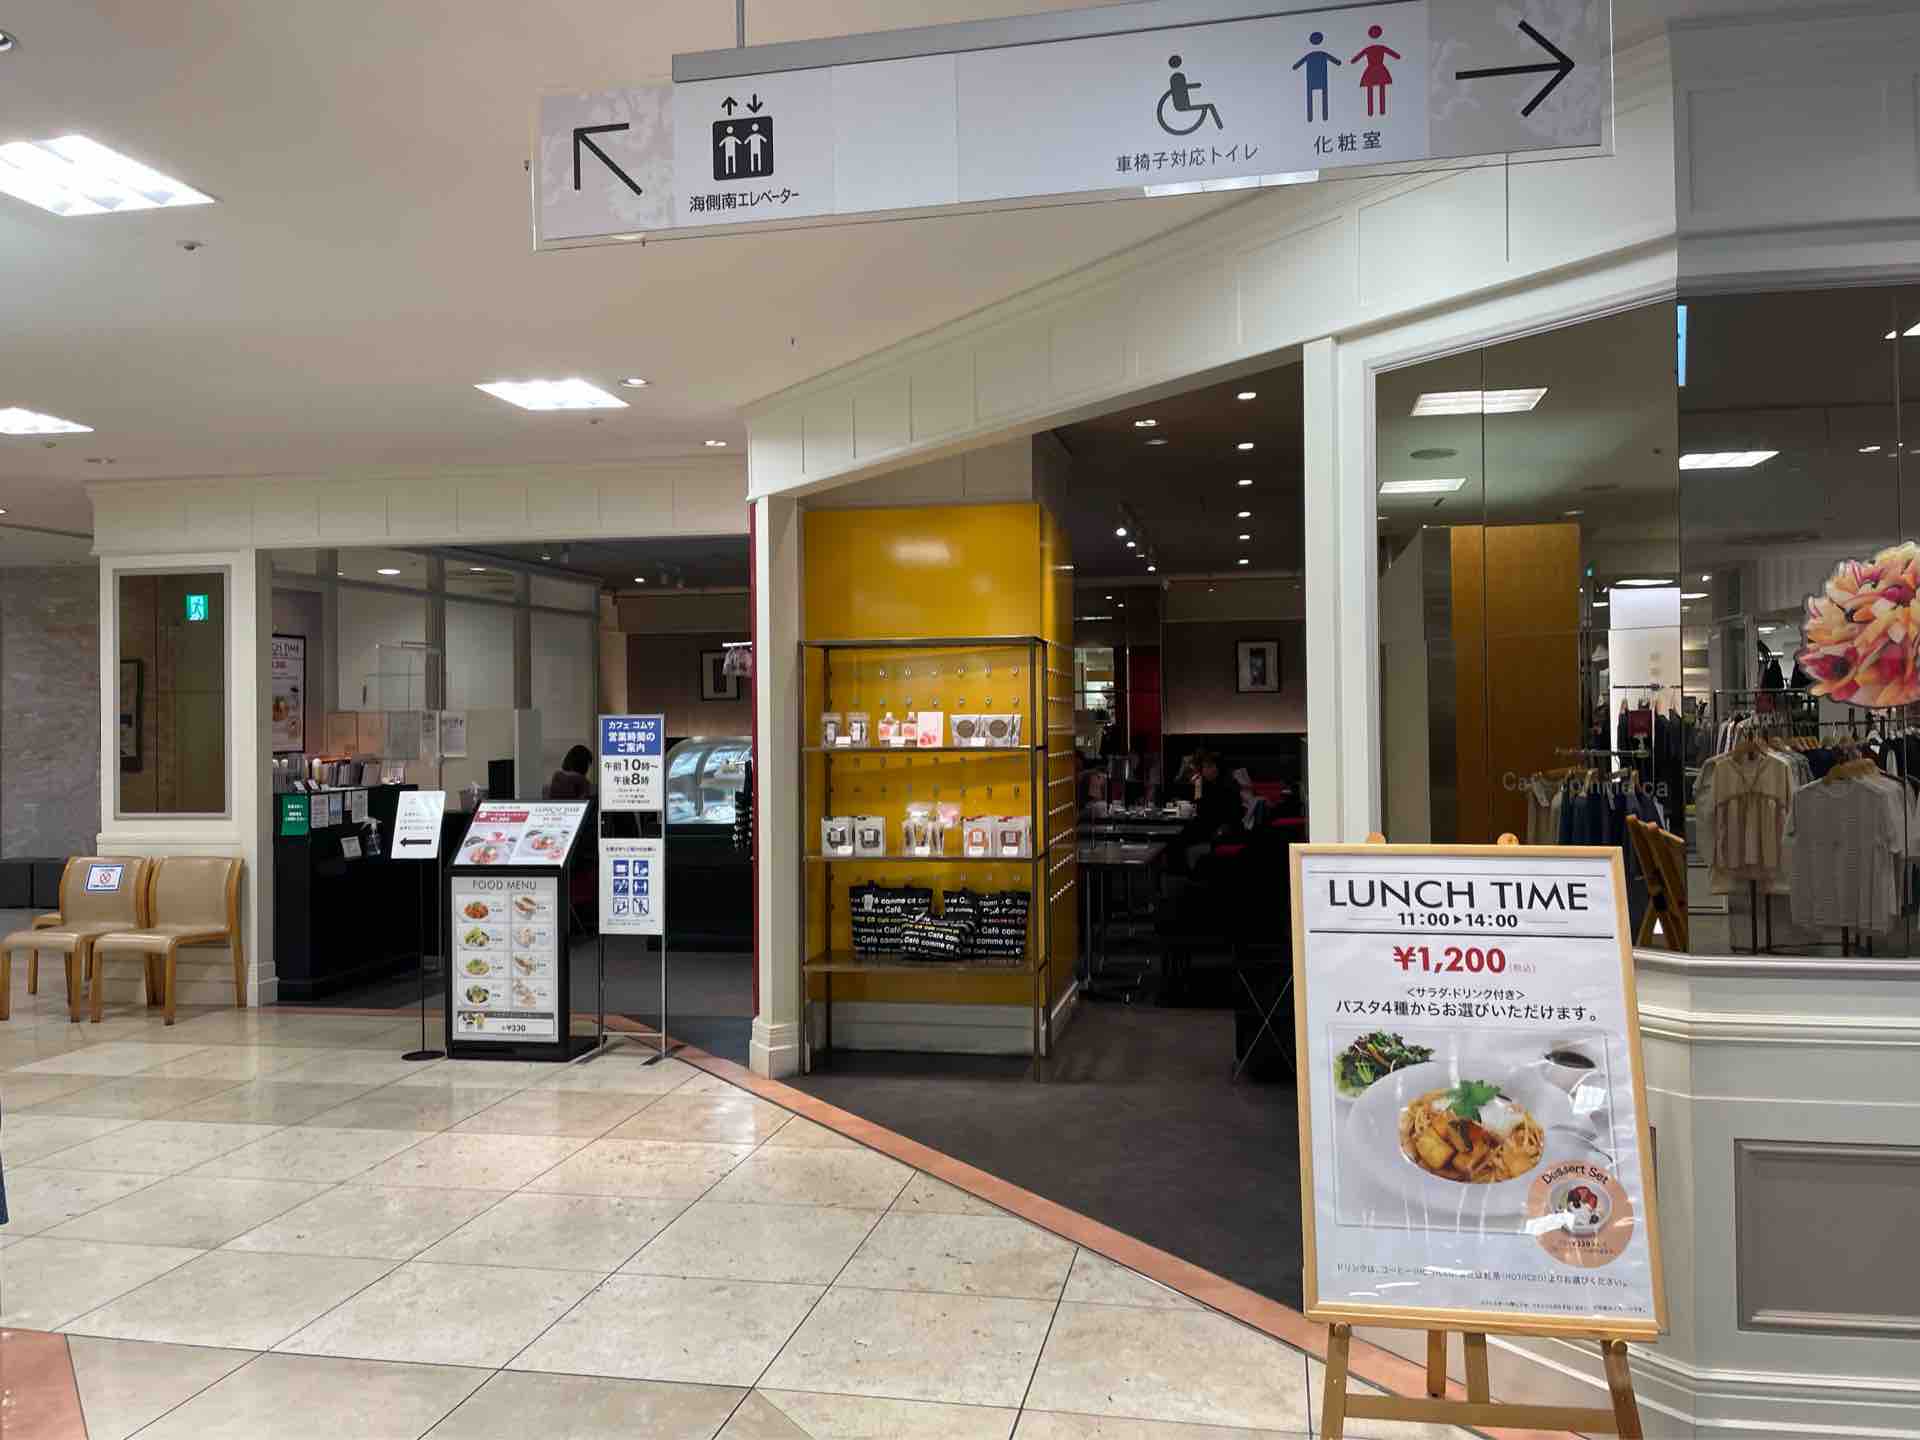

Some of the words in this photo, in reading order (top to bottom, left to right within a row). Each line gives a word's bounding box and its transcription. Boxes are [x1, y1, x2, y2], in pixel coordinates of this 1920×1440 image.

[1313, 130, 1383, 155] 化粧室
[1115, 144, 1259, 173] 車椅子対応トイレ
[689, 187, 800, 213] 海側南エレベーター
[608, 732, 656, 743] 営業時間の
[617, 743, 645, 753] ご案内
[472, 880, 503, 890] FOOD
[506, 880, 536, 890] MENU
[1329, 880, 1474, 908] LUNCH
[1491, 882, 1589, 911] TIME
[1392, 945, 1506, 974] ¥1,200
[1335, 999, 1598, 1023] パスタ4種からお選びいただけます。
[1541, 1165, 1586, 1185] Dessert
[1588, 1167, 1610, 1185] Set
